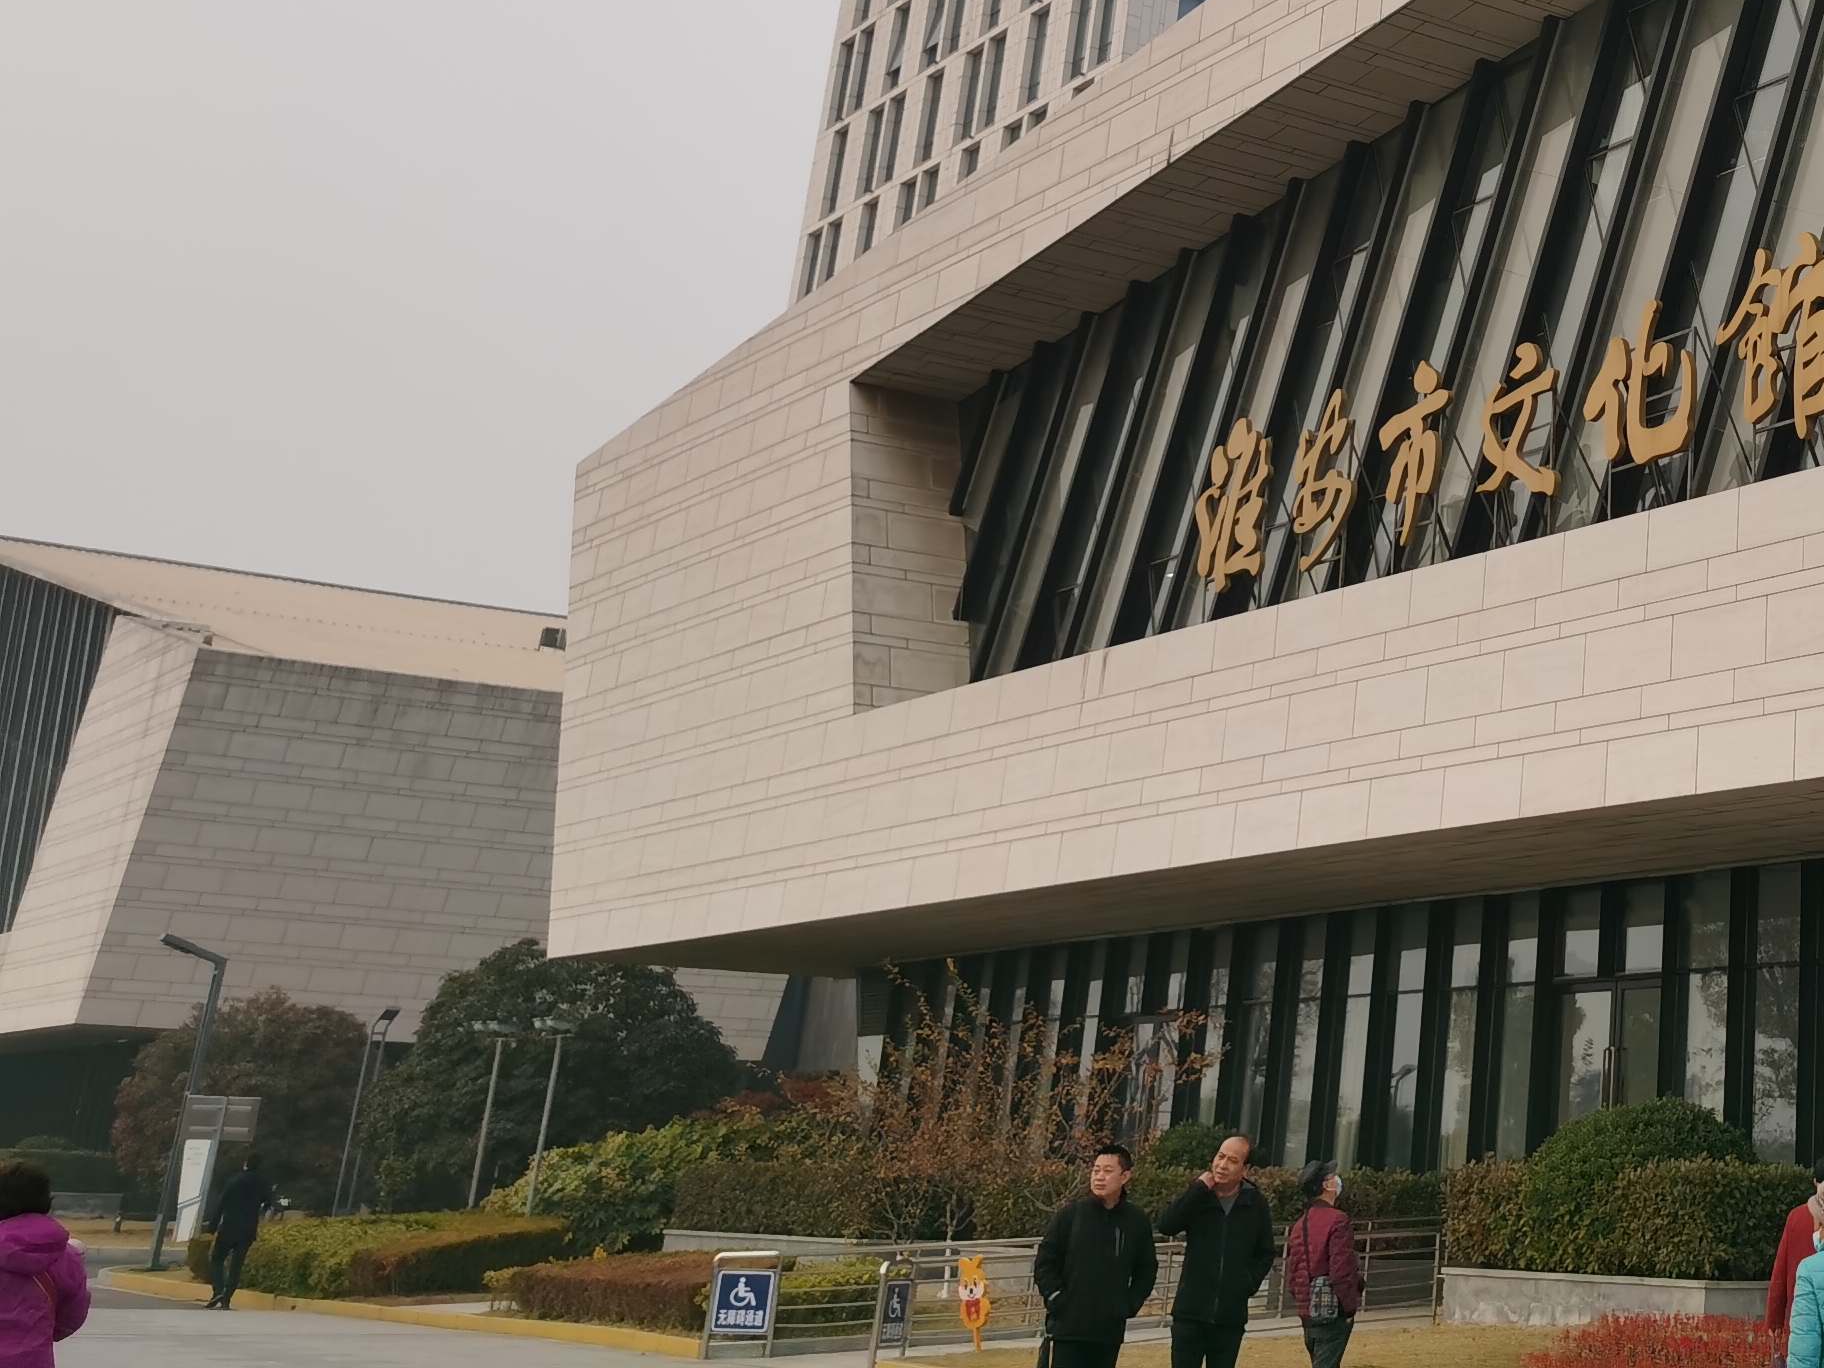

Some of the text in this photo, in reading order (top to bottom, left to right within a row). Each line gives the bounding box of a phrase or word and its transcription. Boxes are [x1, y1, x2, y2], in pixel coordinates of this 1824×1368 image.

[716, 1309, 764, 1326] 无障碍通道
